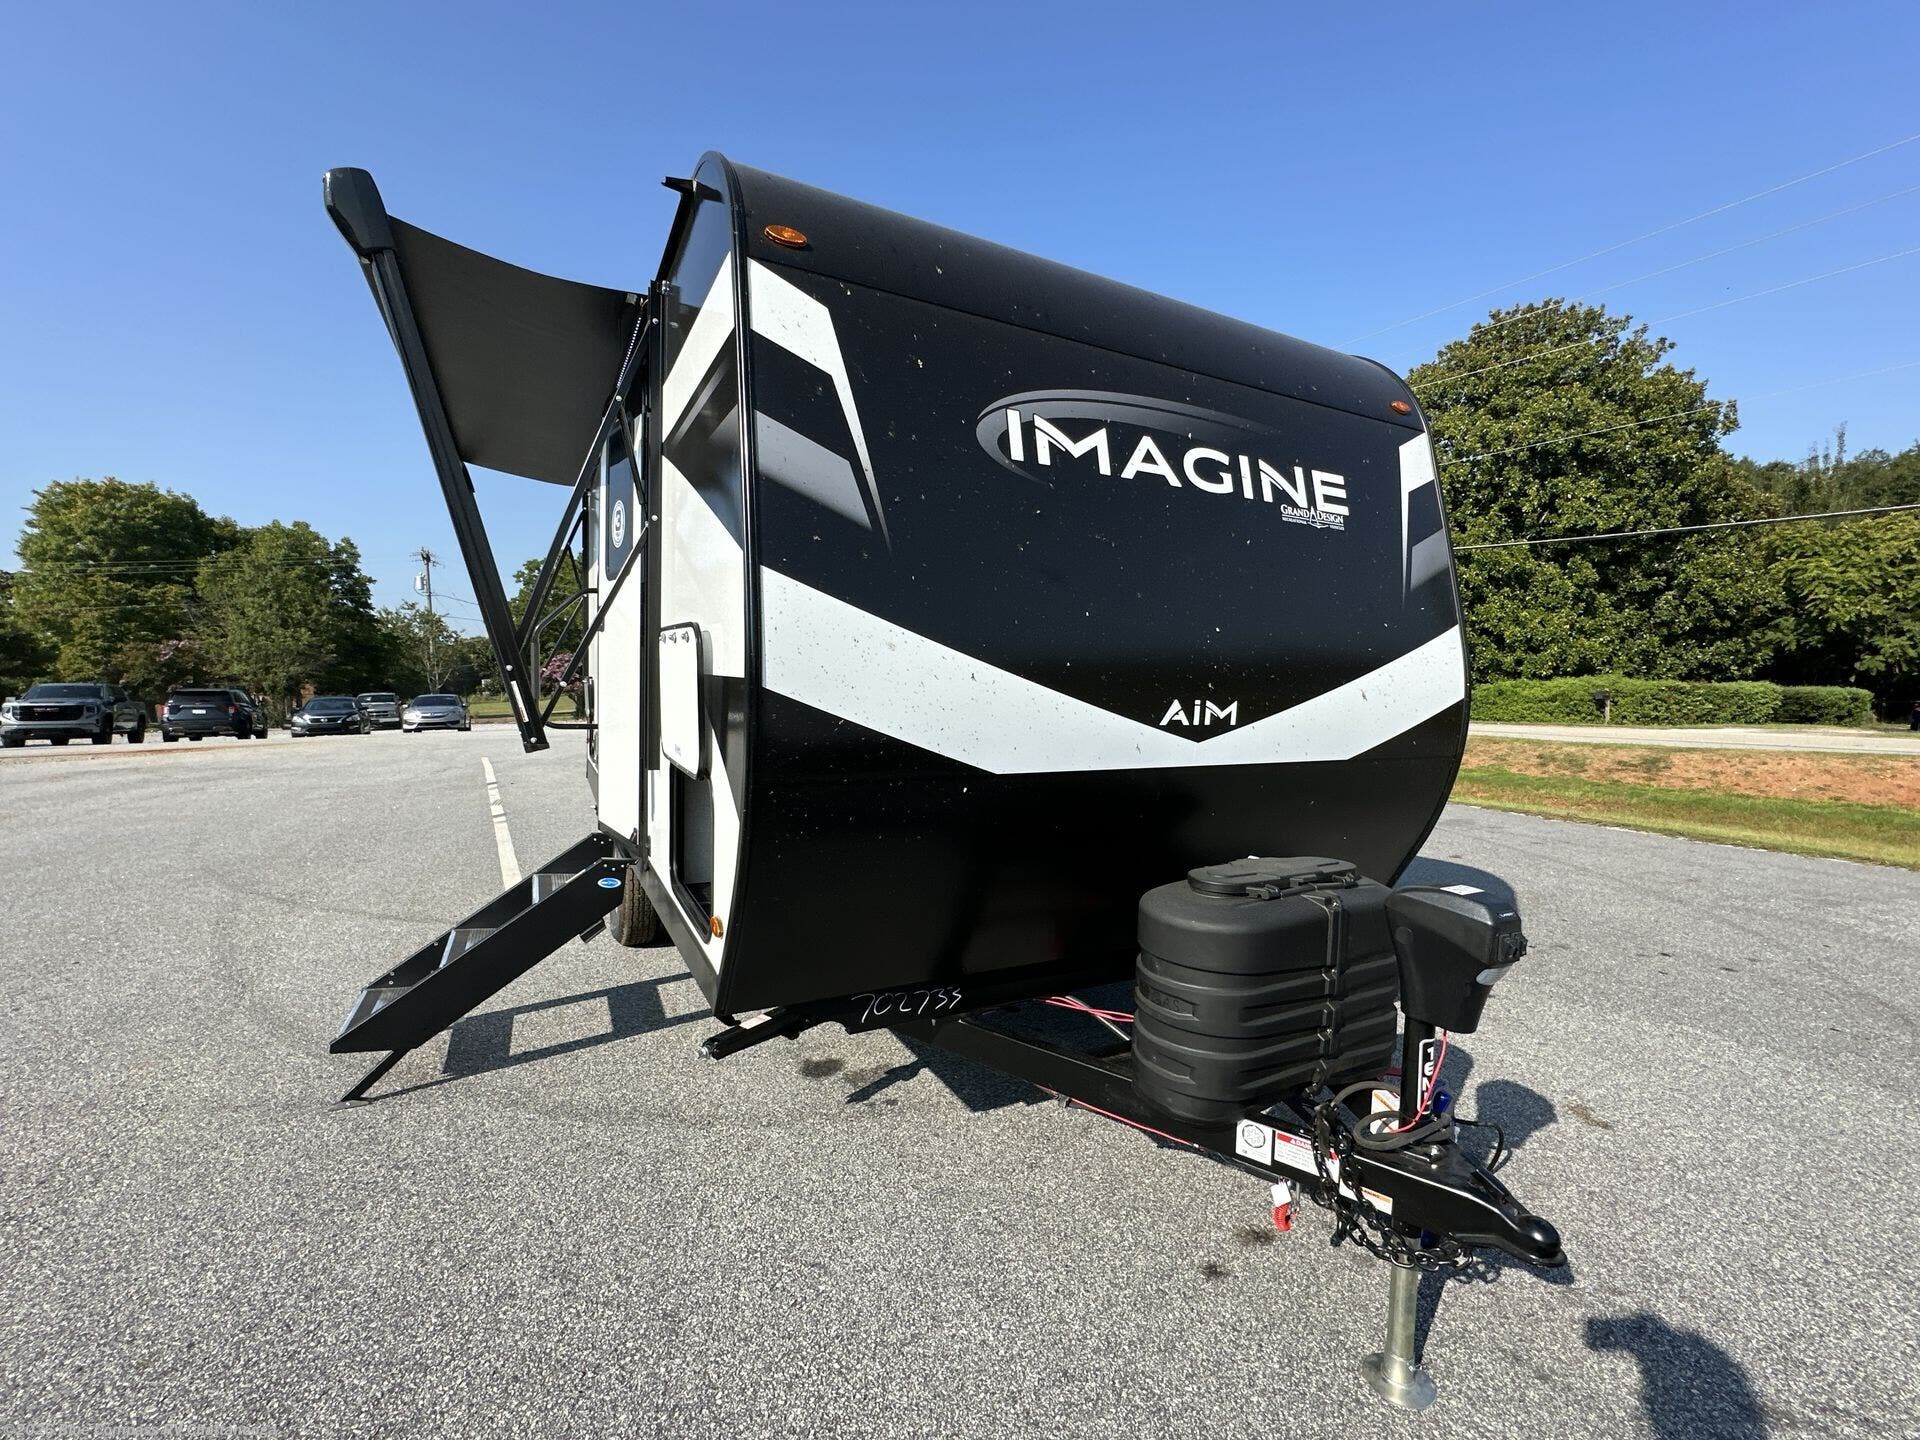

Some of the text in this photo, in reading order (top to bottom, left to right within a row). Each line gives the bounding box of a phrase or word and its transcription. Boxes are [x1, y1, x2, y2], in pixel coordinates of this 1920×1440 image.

[1006, 407, 1349, 515] IMAGINE
[1280, 504, 1310, 518] GRAND
[1316, 510, 1344, 524] DESIGN
